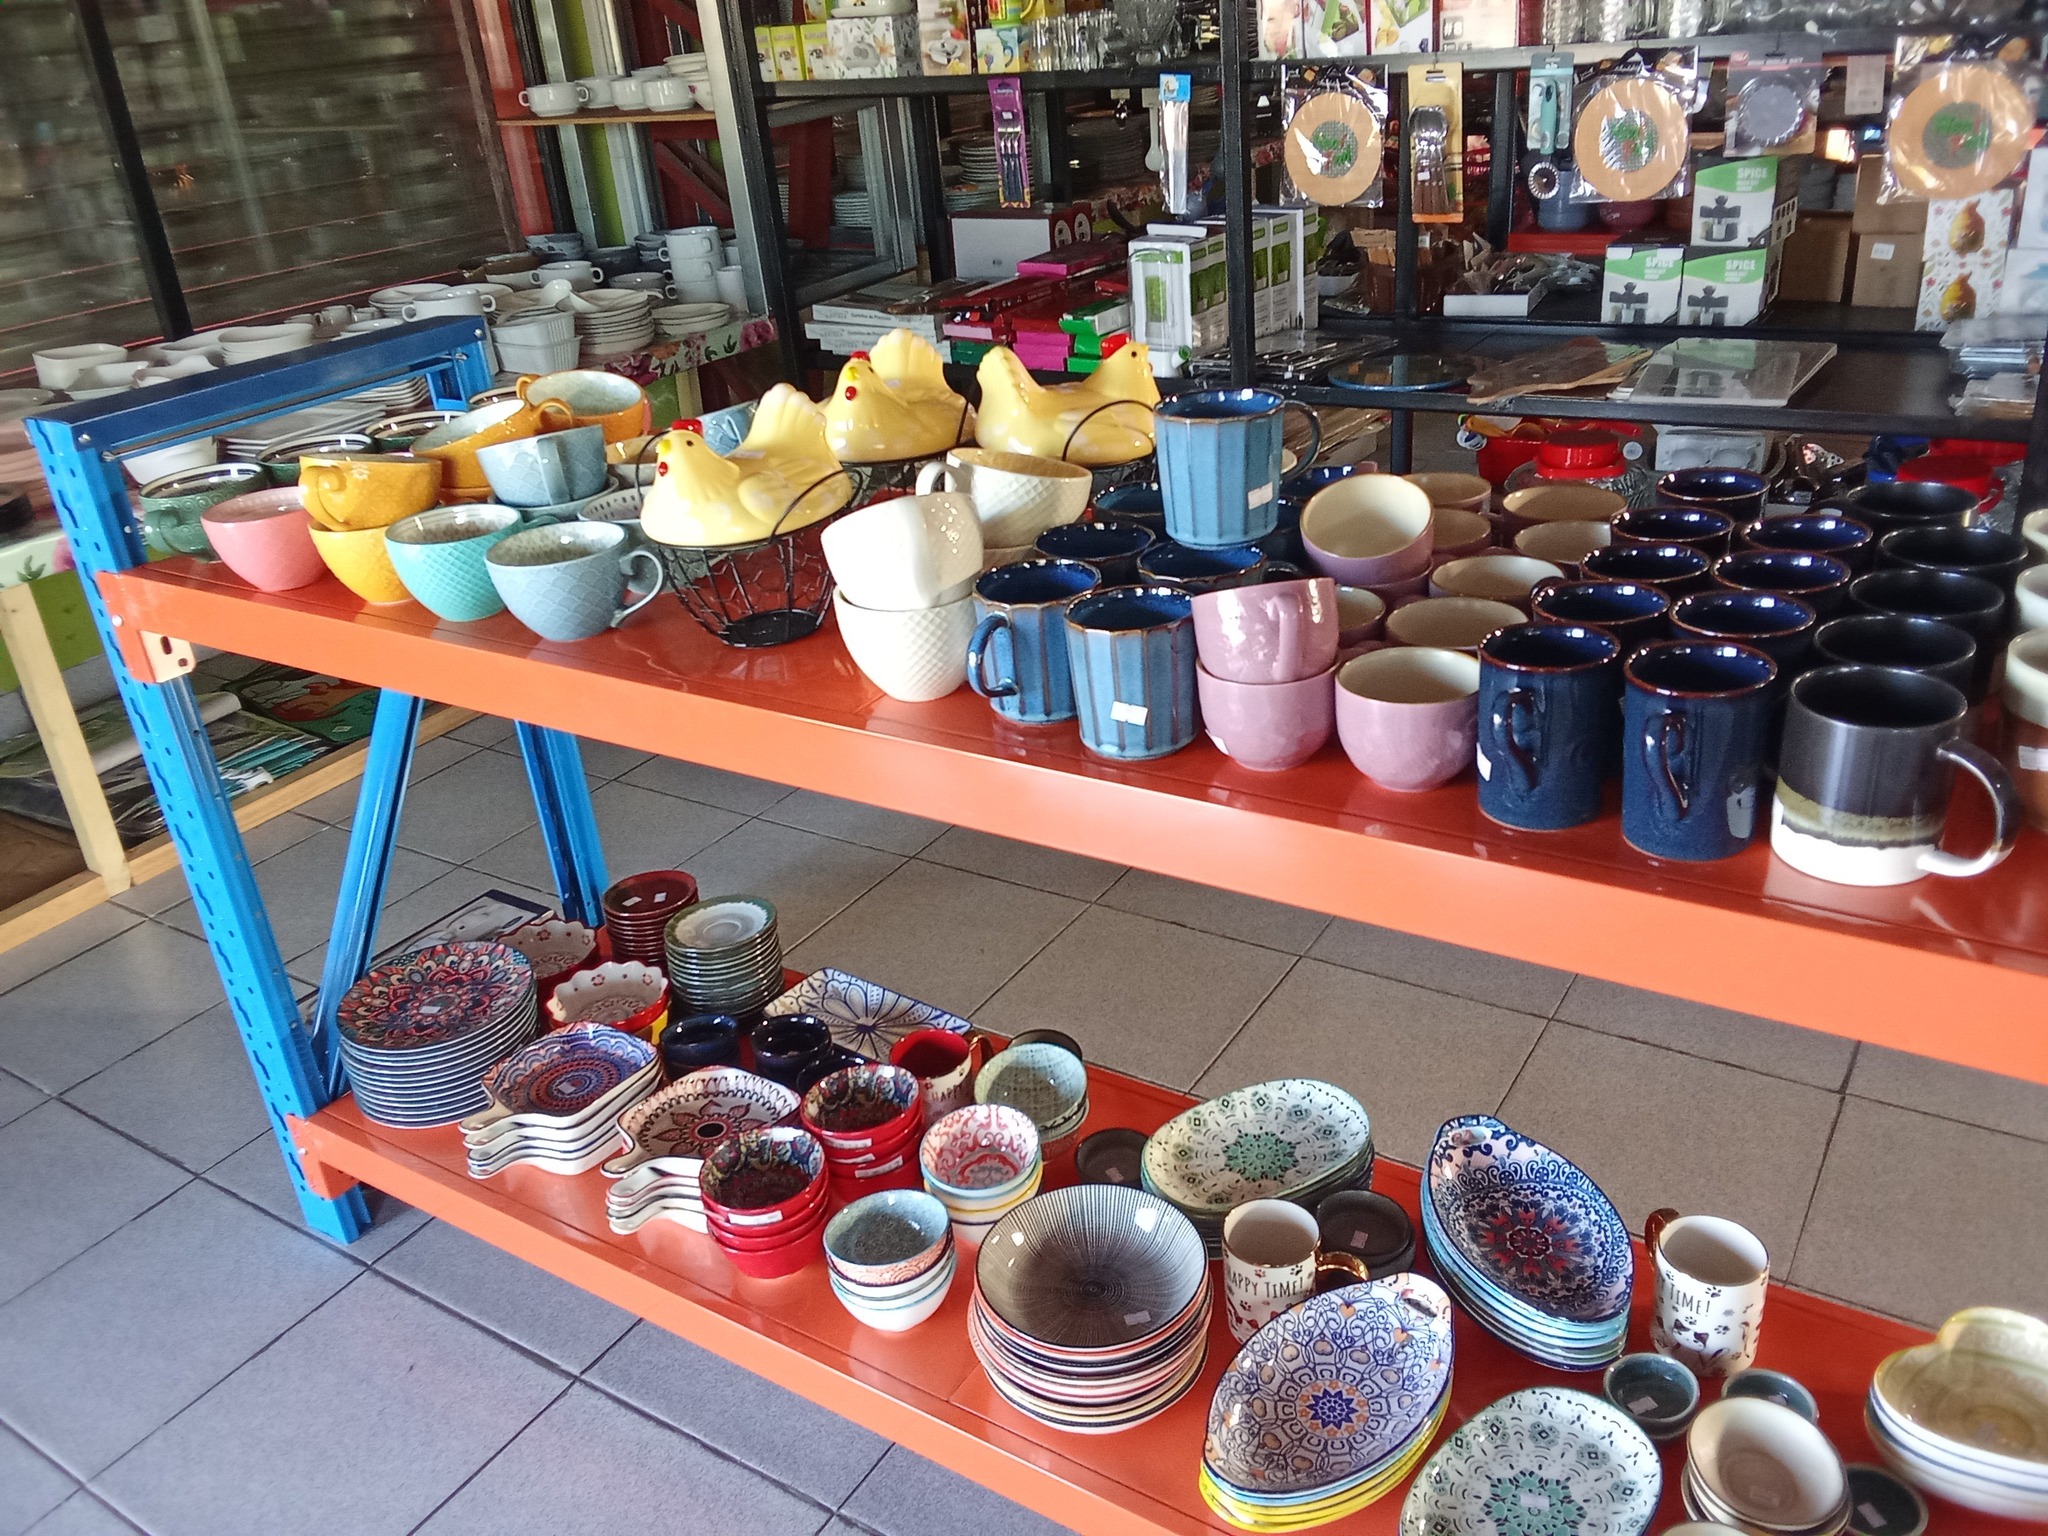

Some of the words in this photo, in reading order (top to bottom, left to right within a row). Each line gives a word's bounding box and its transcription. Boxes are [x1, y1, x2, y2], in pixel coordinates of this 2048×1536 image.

[1443, 21, 1463, 37] #8
[1737, 167, 1768, 179] SPICE
[1725, 259, 1756, 270] SPICE
[930, 1084, 963, 1102] HAPP
[1265, 1276, 1303, 1299] TIME!
[1669, 1283, 1711, 1317] TIME!
